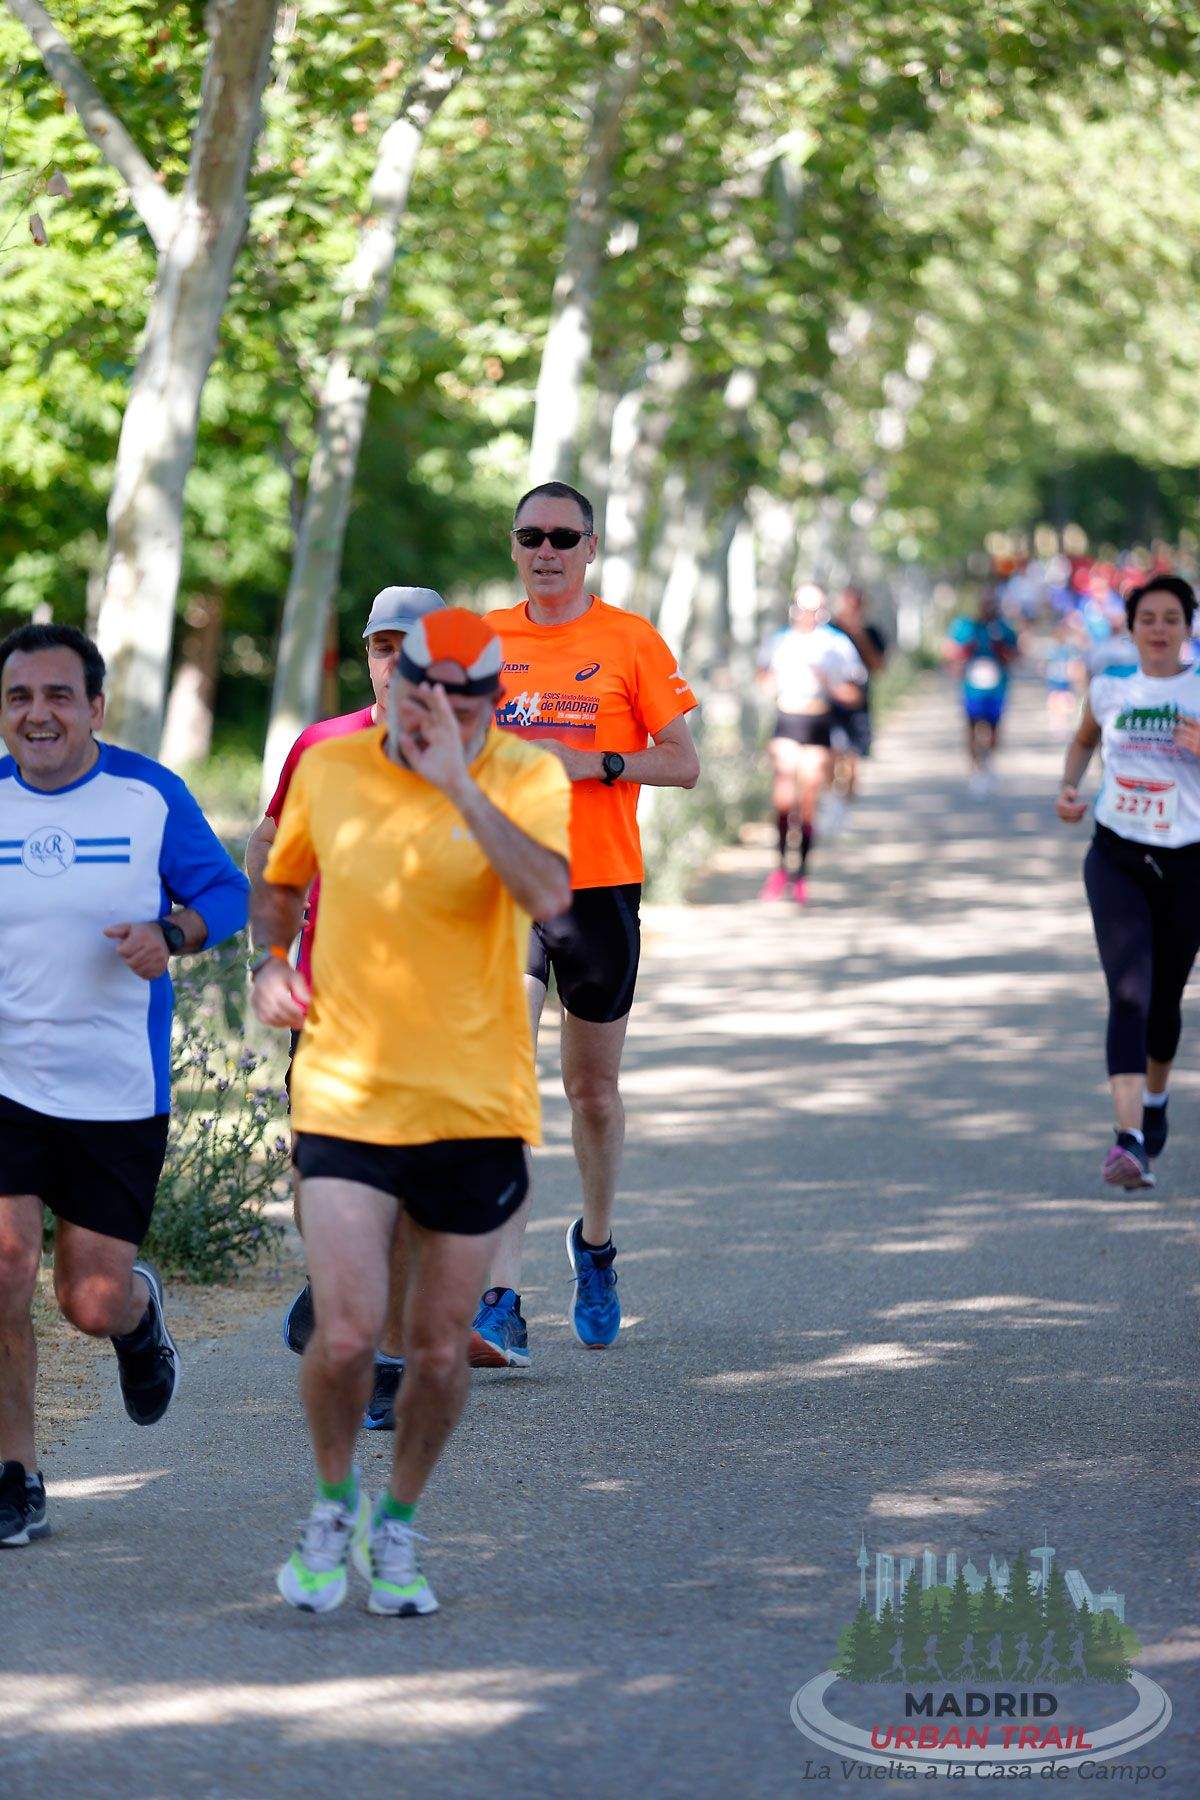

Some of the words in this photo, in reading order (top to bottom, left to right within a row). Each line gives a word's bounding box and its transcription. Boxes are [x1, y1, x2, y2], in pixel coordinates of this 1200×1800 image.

[541, 700, 554, 711] de
[555, 700, 599, 714] MADRID
[1116, 794, 1165, 816] 2271
